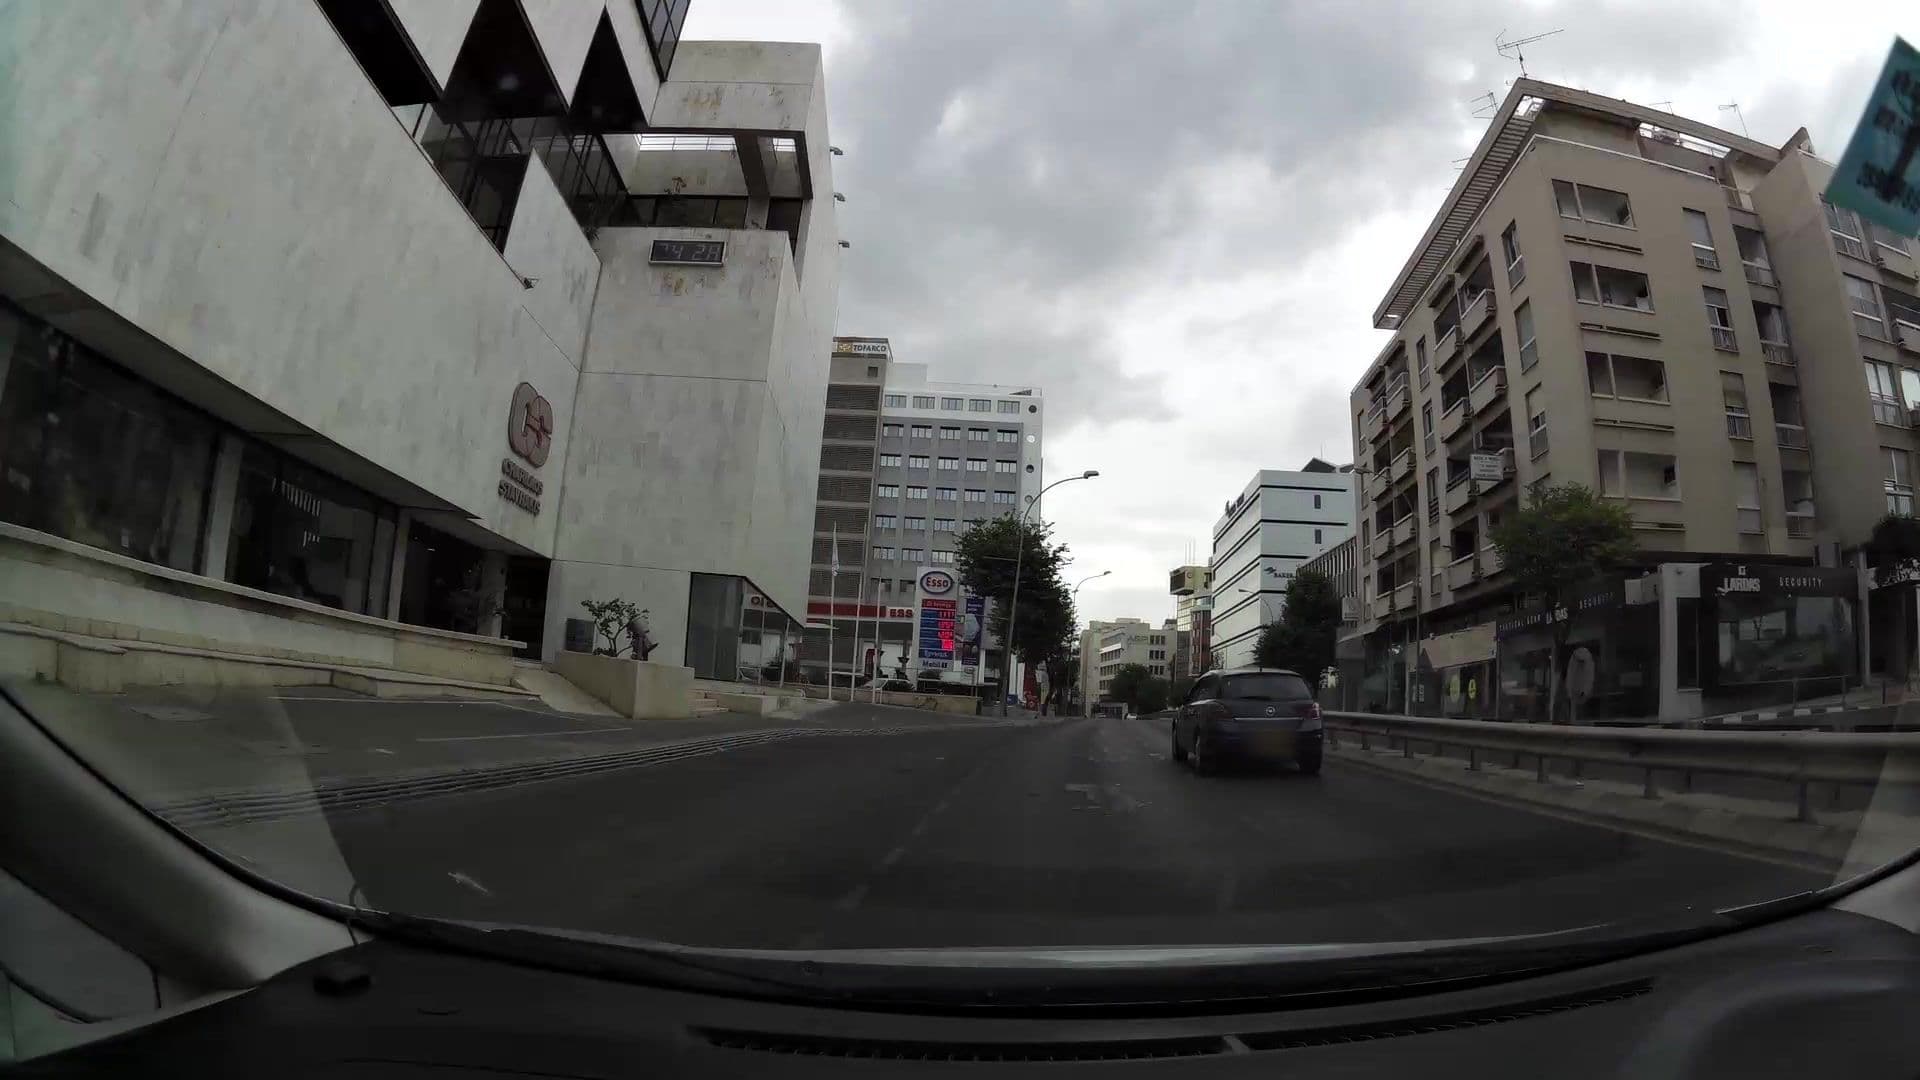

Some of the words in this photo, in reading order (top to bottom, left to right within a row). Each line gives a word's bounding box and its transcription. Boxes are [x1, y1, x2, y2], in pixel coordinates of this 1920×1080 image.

[926, 577, 949, 587] Esso
[1724, 578, 1760, 592] LARDAS
[1780, 577, 1823, 588] SECURITY
[890, 608, 913, 618] ESS
[1546, 607, 1568, 624] LADAS
